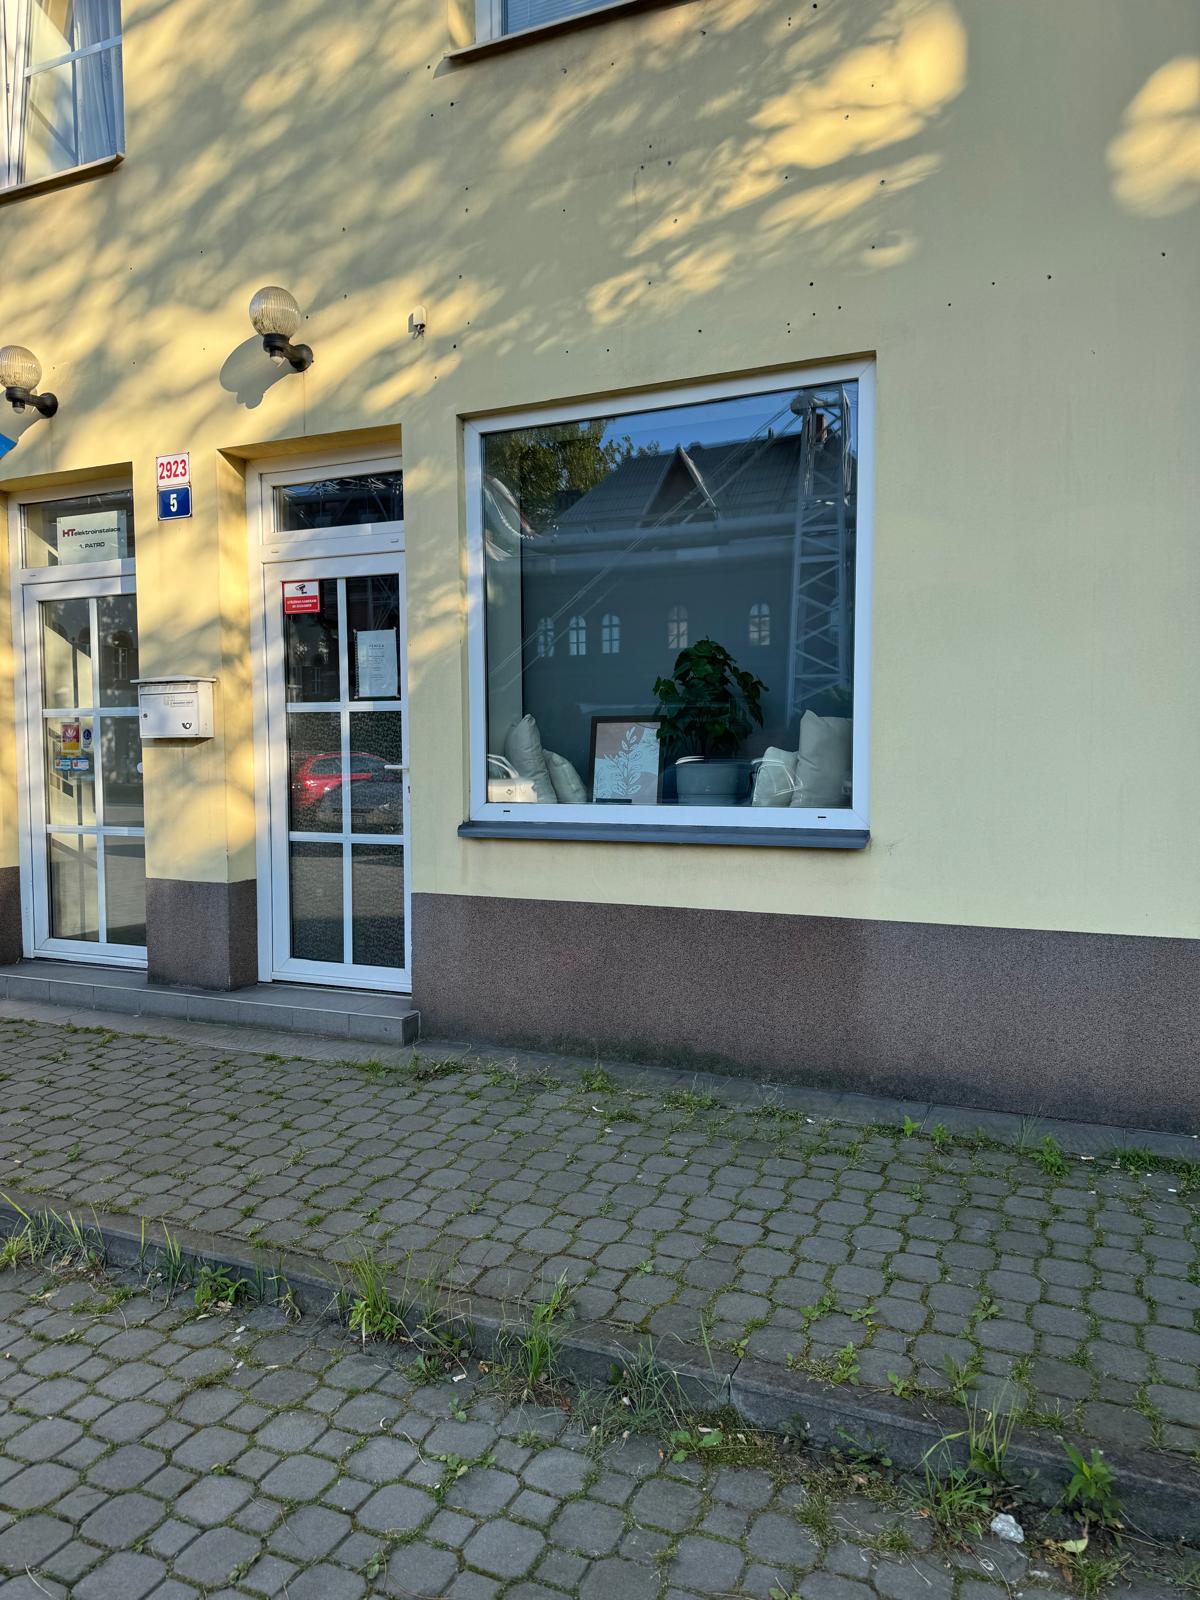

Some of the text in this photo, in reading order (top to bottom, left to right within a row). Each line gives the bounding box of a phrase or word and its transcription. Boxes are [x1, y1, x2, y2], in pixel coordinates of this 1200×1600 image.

[159, 459, 187, 480] 2923
[170, 493, 178, 512] 5
[84, 541, 105, 549] PATRO
